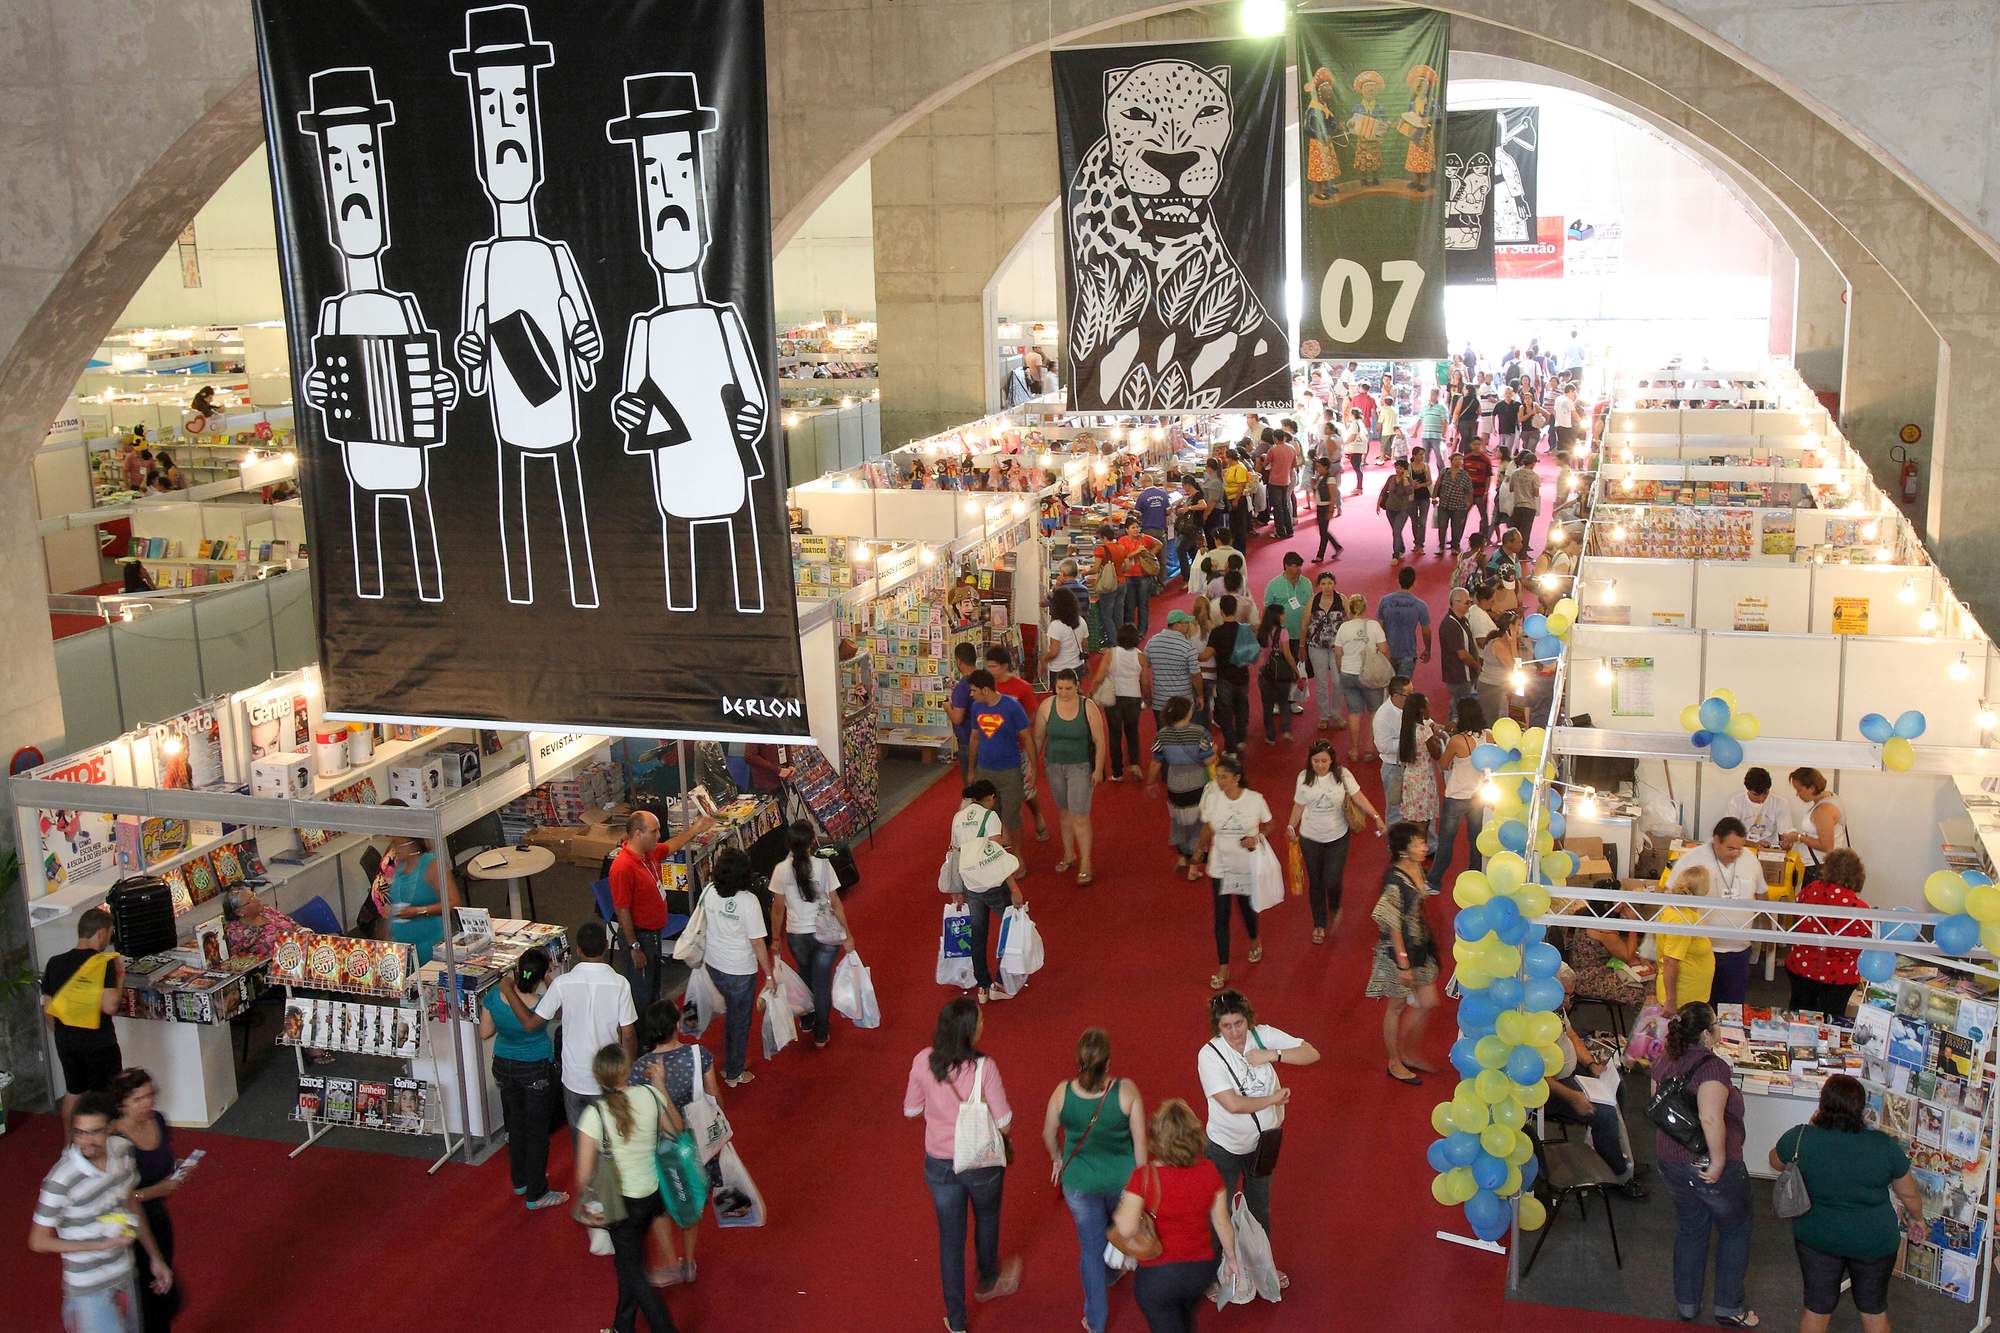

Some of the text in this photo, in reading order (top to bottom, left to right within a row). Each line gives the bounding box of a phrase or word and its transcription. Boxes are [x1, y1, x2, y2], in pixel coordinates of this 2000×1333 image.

[1320, 258, 1425, 343] 07
[1256, 400, 1292, 409] DERLON
[722, 696, 801, 718] DERLON
[540, 733, 574, 759] REVISTA
[359, 1083, 387, 1096] Dinheiro
[394, 1077, 417, 1090] Gente
